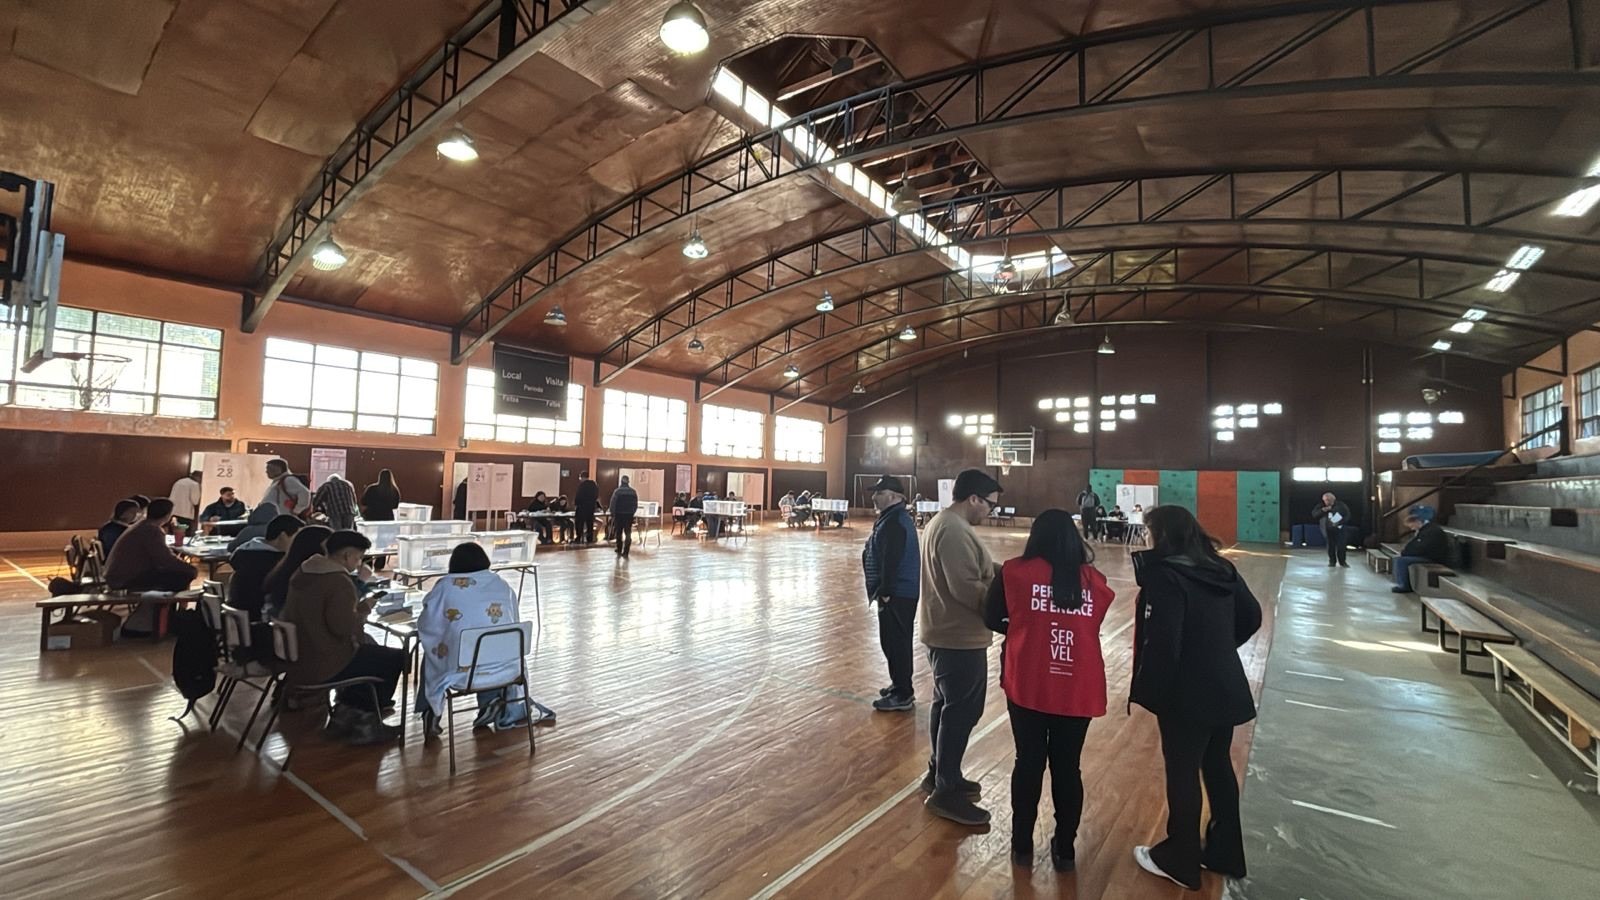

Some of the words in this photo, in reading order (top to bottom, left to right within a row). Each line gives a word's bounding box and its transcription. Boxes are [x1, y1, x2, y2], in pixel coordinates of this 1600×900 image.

[502, 369, 521, 380] Local
[545, 377, 564, 387] Visita
[216, 467, 233, 478] 28
[1032, 584, 1093, 603] PERAL
[1031, 598, 1048, 611] DE
[1050, 629, 1074, 646] SER
[1050, 644, 1074, 662] VEL
